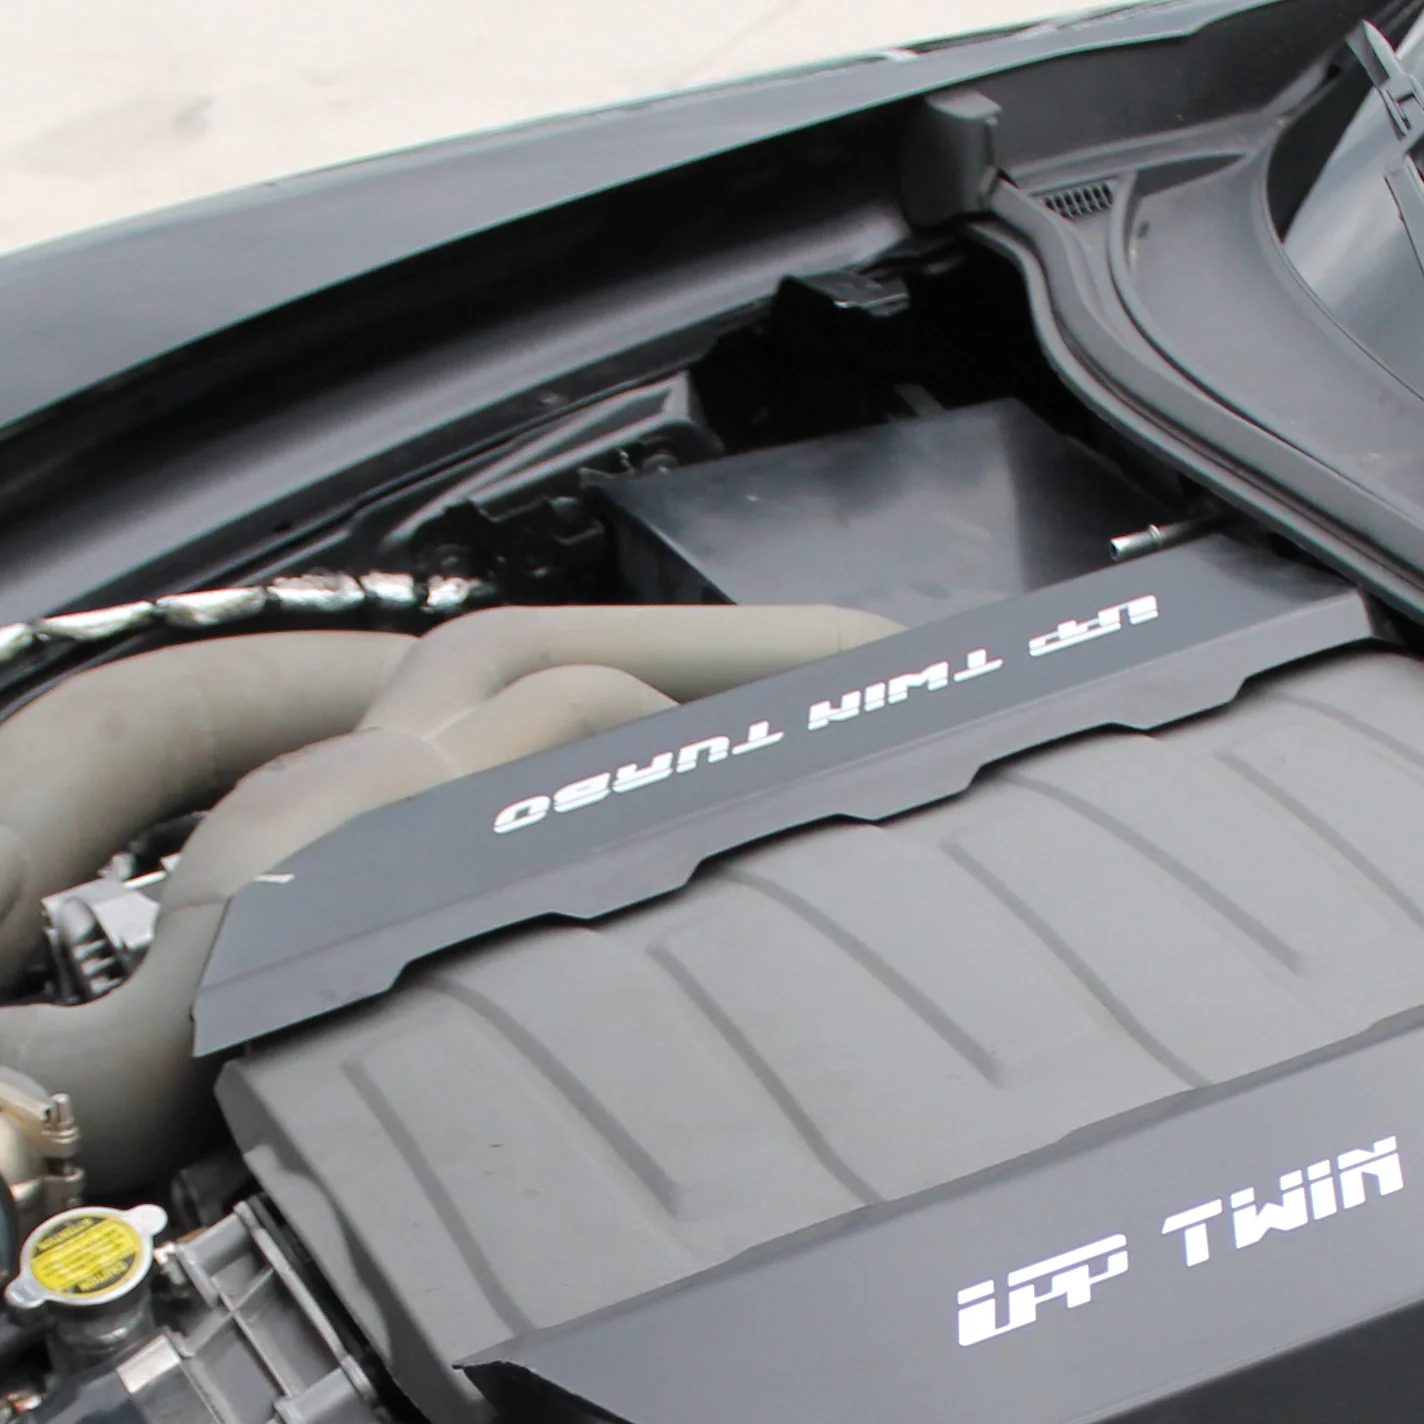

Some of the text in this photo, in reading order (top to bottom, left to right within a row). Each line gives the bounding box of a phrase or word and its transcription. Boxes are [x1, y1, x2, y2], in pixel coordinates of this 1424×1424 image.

[807, 648, 1003, 731] TWIN
[492, 720, 784, 835] TURBO
[1161, 1135, 1405, 1268] TWIN
